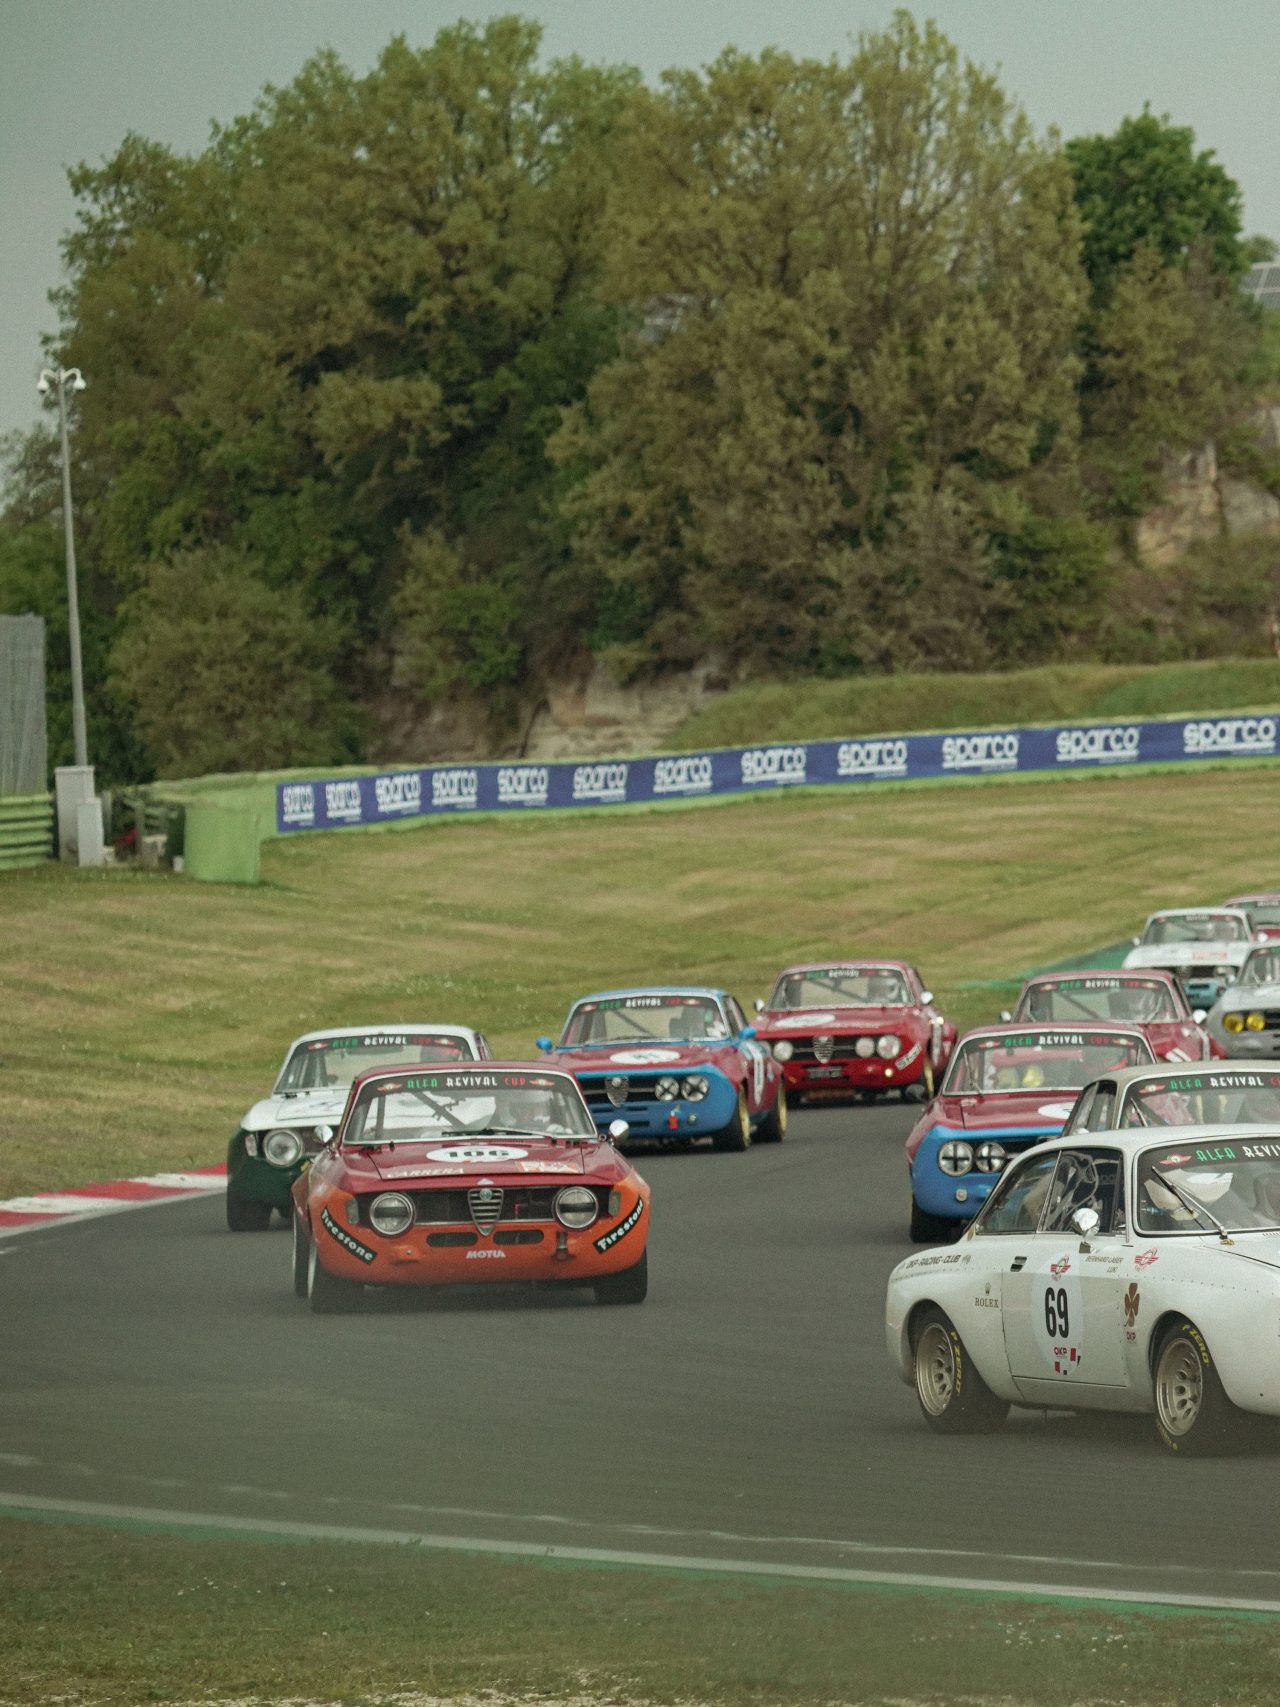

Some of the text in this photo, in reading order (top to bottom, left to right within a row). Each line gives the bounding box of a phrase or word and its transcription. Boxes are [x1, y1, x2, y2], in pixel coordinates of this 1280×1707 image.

[1056, 727, 1140, 758] sparco
[1183, 718, 1277, 750] sparco
[742, 747, 807, 781] sparco
[837, 740, 908, 770] sparco
[942, 735, 1018, 766] sparco
[432, 769, 477, 800] sparco
[497, 767, 548, 798] sparco
[573, 764, 627, 795] sparco
[653, 757, 712, 788] sparco
[375, 773, 421, 808] sparco
[364, 1036, 407, 1046] REVIVAL
[1038, 1035, 1084, 1045] REVIVAL
[446, 1077, 498, 1087] REVIVAL
[1170, 1078, 1202, 1089] ALFA
[1210, 1076, 1265, 1087] REVIVAL
[1196, 1146, 1236, 1162] ALFA
[321, 1208, 375, 1262] Firestone
[598, 1199, 644, 1251] Firestone
[975, 1298, 999, 1308] ROLEX
[1045, 1287, 1069, 1338] 69
